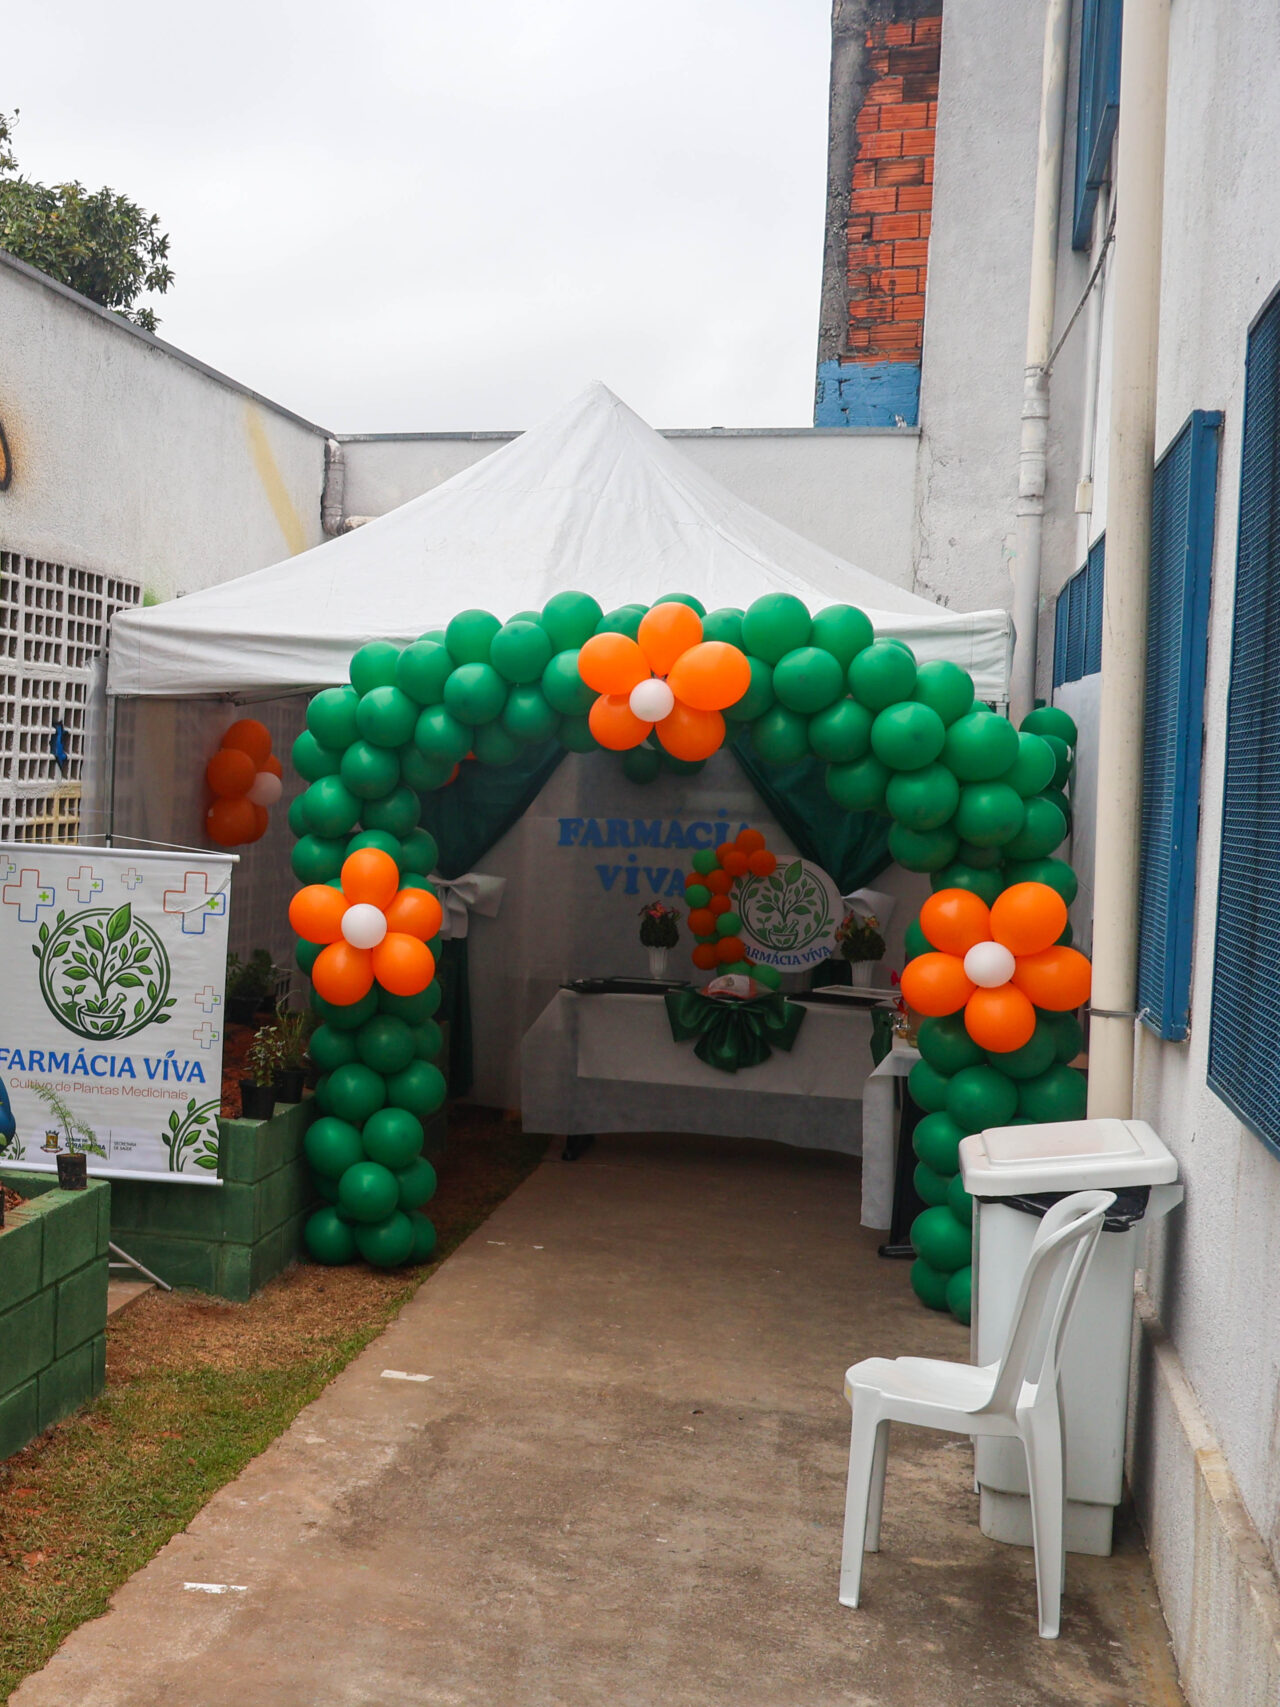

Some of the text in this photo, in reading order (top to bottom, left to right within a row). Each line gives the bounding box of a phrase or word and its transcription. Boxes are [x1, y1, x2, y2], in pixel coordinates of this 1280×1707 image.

[558, 807, 750, 850] FARMÁCI
[744, 942, 801, 966] ARMÁCIA
[144, 1050, 206, 1083] VÍVA
[9, 1077, 189, 1101] Cultivo de Plantas Medicinais
